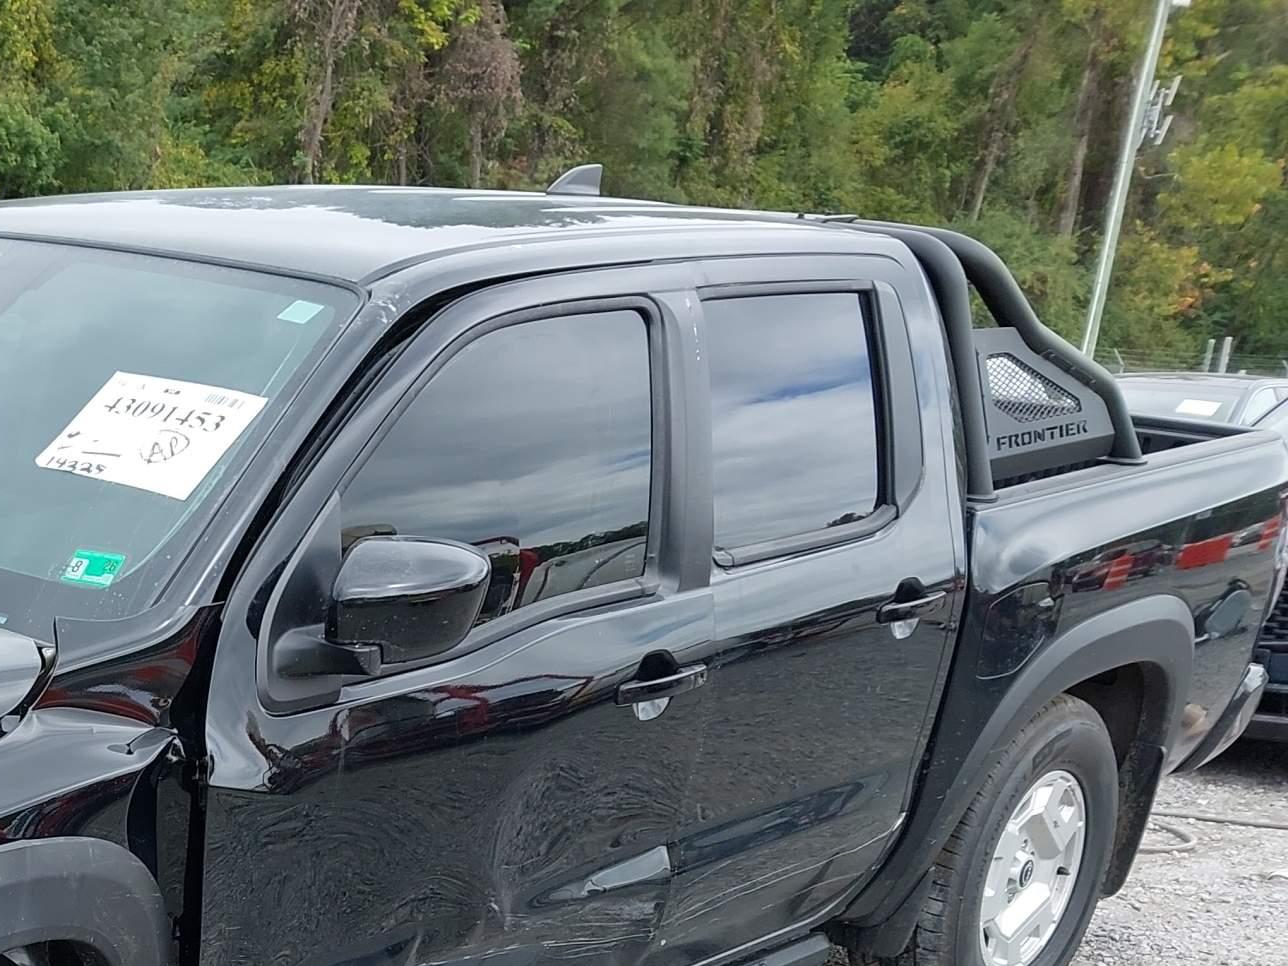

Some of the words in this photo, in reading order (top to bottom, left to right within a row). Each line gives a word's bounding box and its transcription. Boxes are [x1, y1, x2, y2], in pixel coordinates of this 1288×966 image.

[103, 396, 227, 433] 43091453
[996, 419, 1089, 451] FRONTIER
[71, 560, 84, 573] 8
